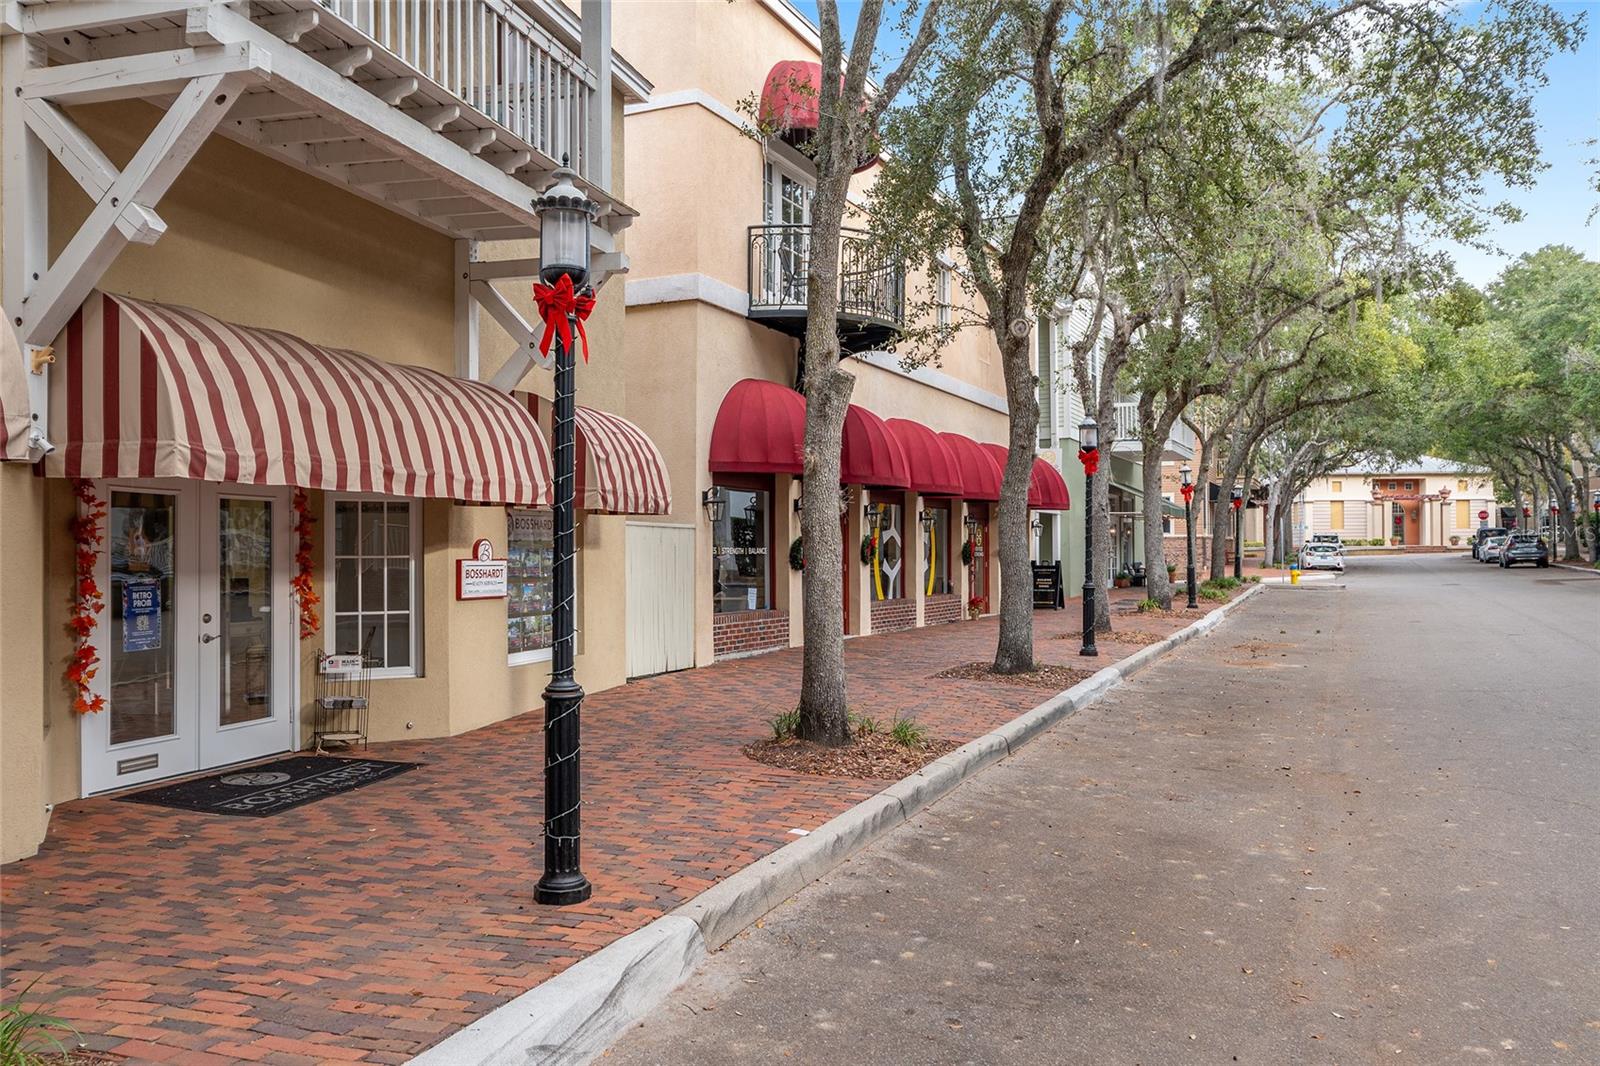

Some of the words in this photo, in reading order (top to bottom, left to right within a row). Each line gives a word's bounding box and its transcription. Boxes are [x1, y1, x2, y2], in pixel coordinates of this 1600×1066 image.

[515, 518, 554, 530] BOSSHARD
[721, 547, 745, 555] STRENGTH
[748, 547, 768, 555] BALANCE
[465, 569, 504, 579] BOSSHARDT
[132, 591, 152, 599] RETRO
[132, 599, 152, 607] PROM
[222, 762, 384, 810] BOSSHARDT
